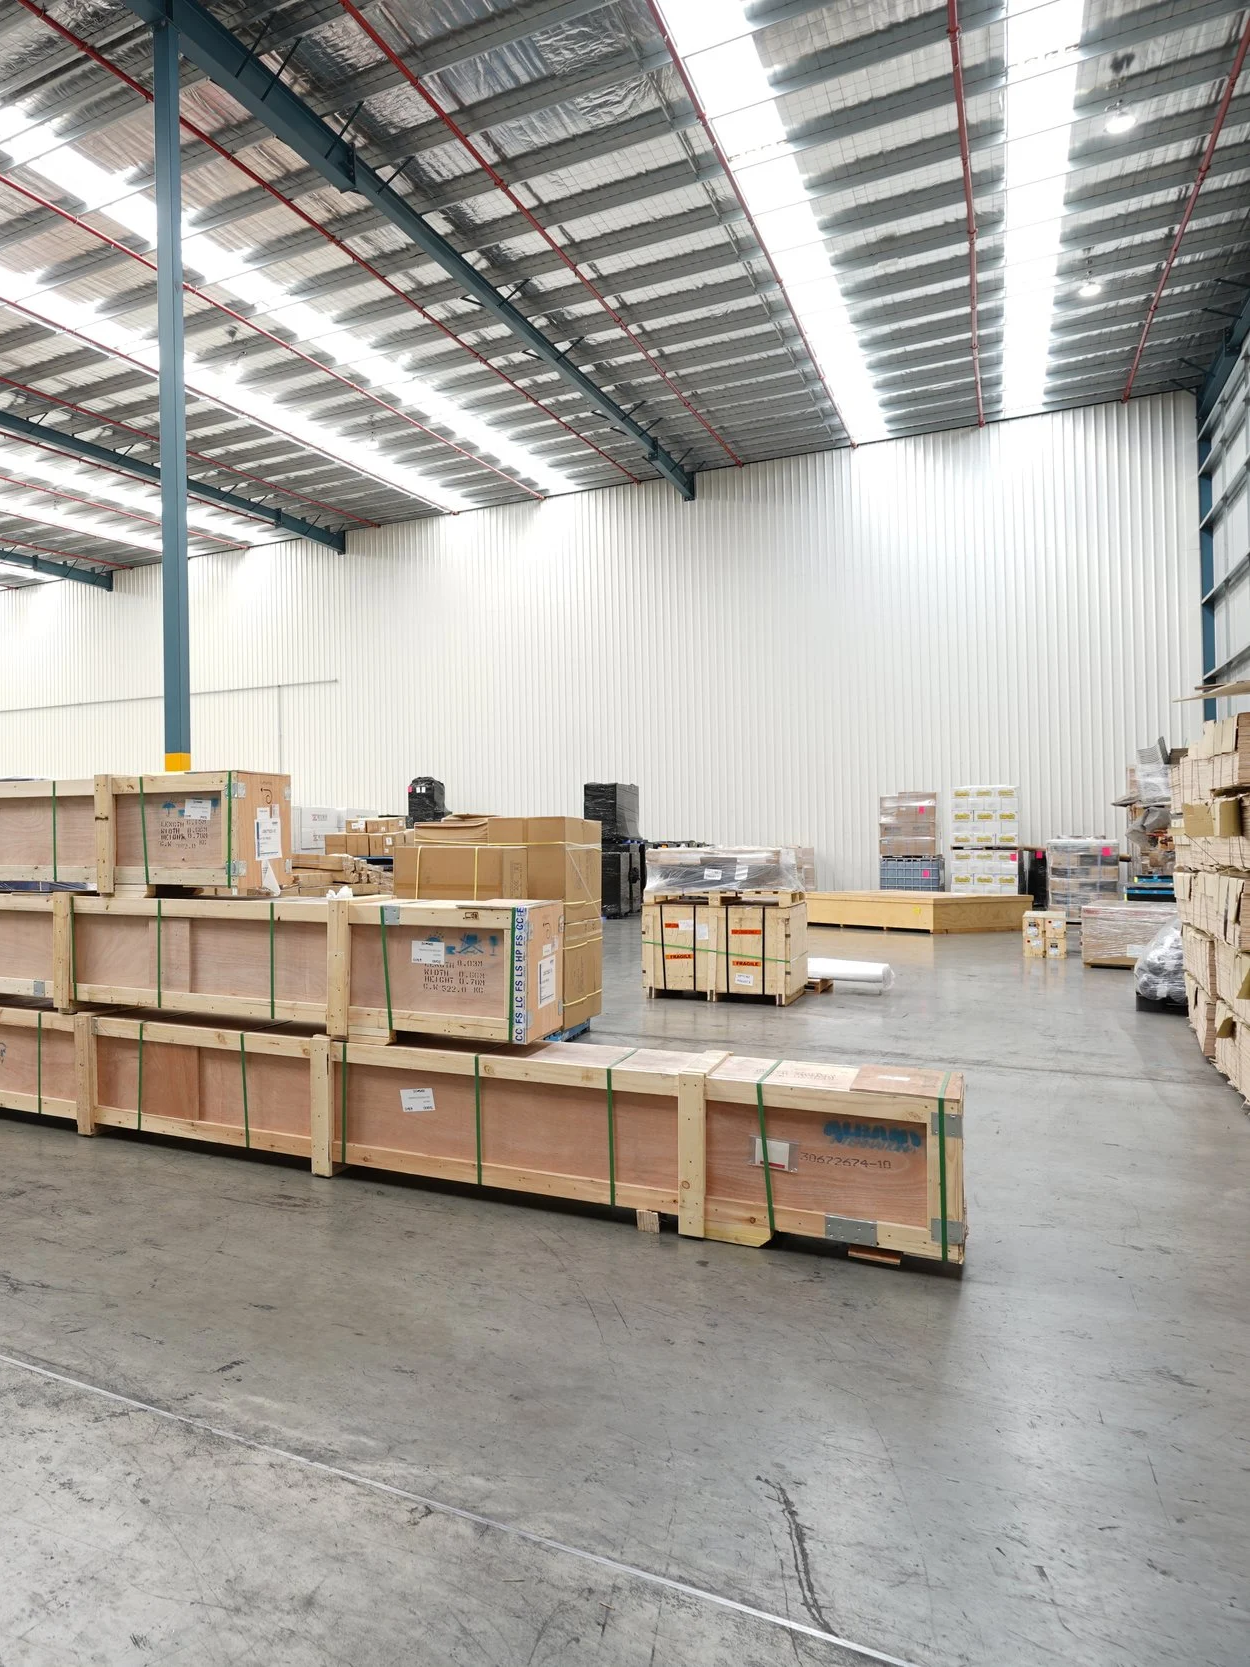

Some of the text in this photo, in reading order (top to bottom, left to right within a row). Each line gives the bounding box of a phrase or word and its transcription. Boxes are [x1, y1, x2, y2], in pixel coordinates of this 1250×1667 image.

[515, 934, 524, 946] FS
[423, 969, 449, 977] WIDTH
[515, 965, 523, 977] LS
[424, 976, 454, 984] HEIGHT
[515, 980, 523, 992] FS
[515, 996, 523, 1008] LC
[515, 1012, 523, 1024] FS
[799, 1151, 892, 1169] 30672674-10
